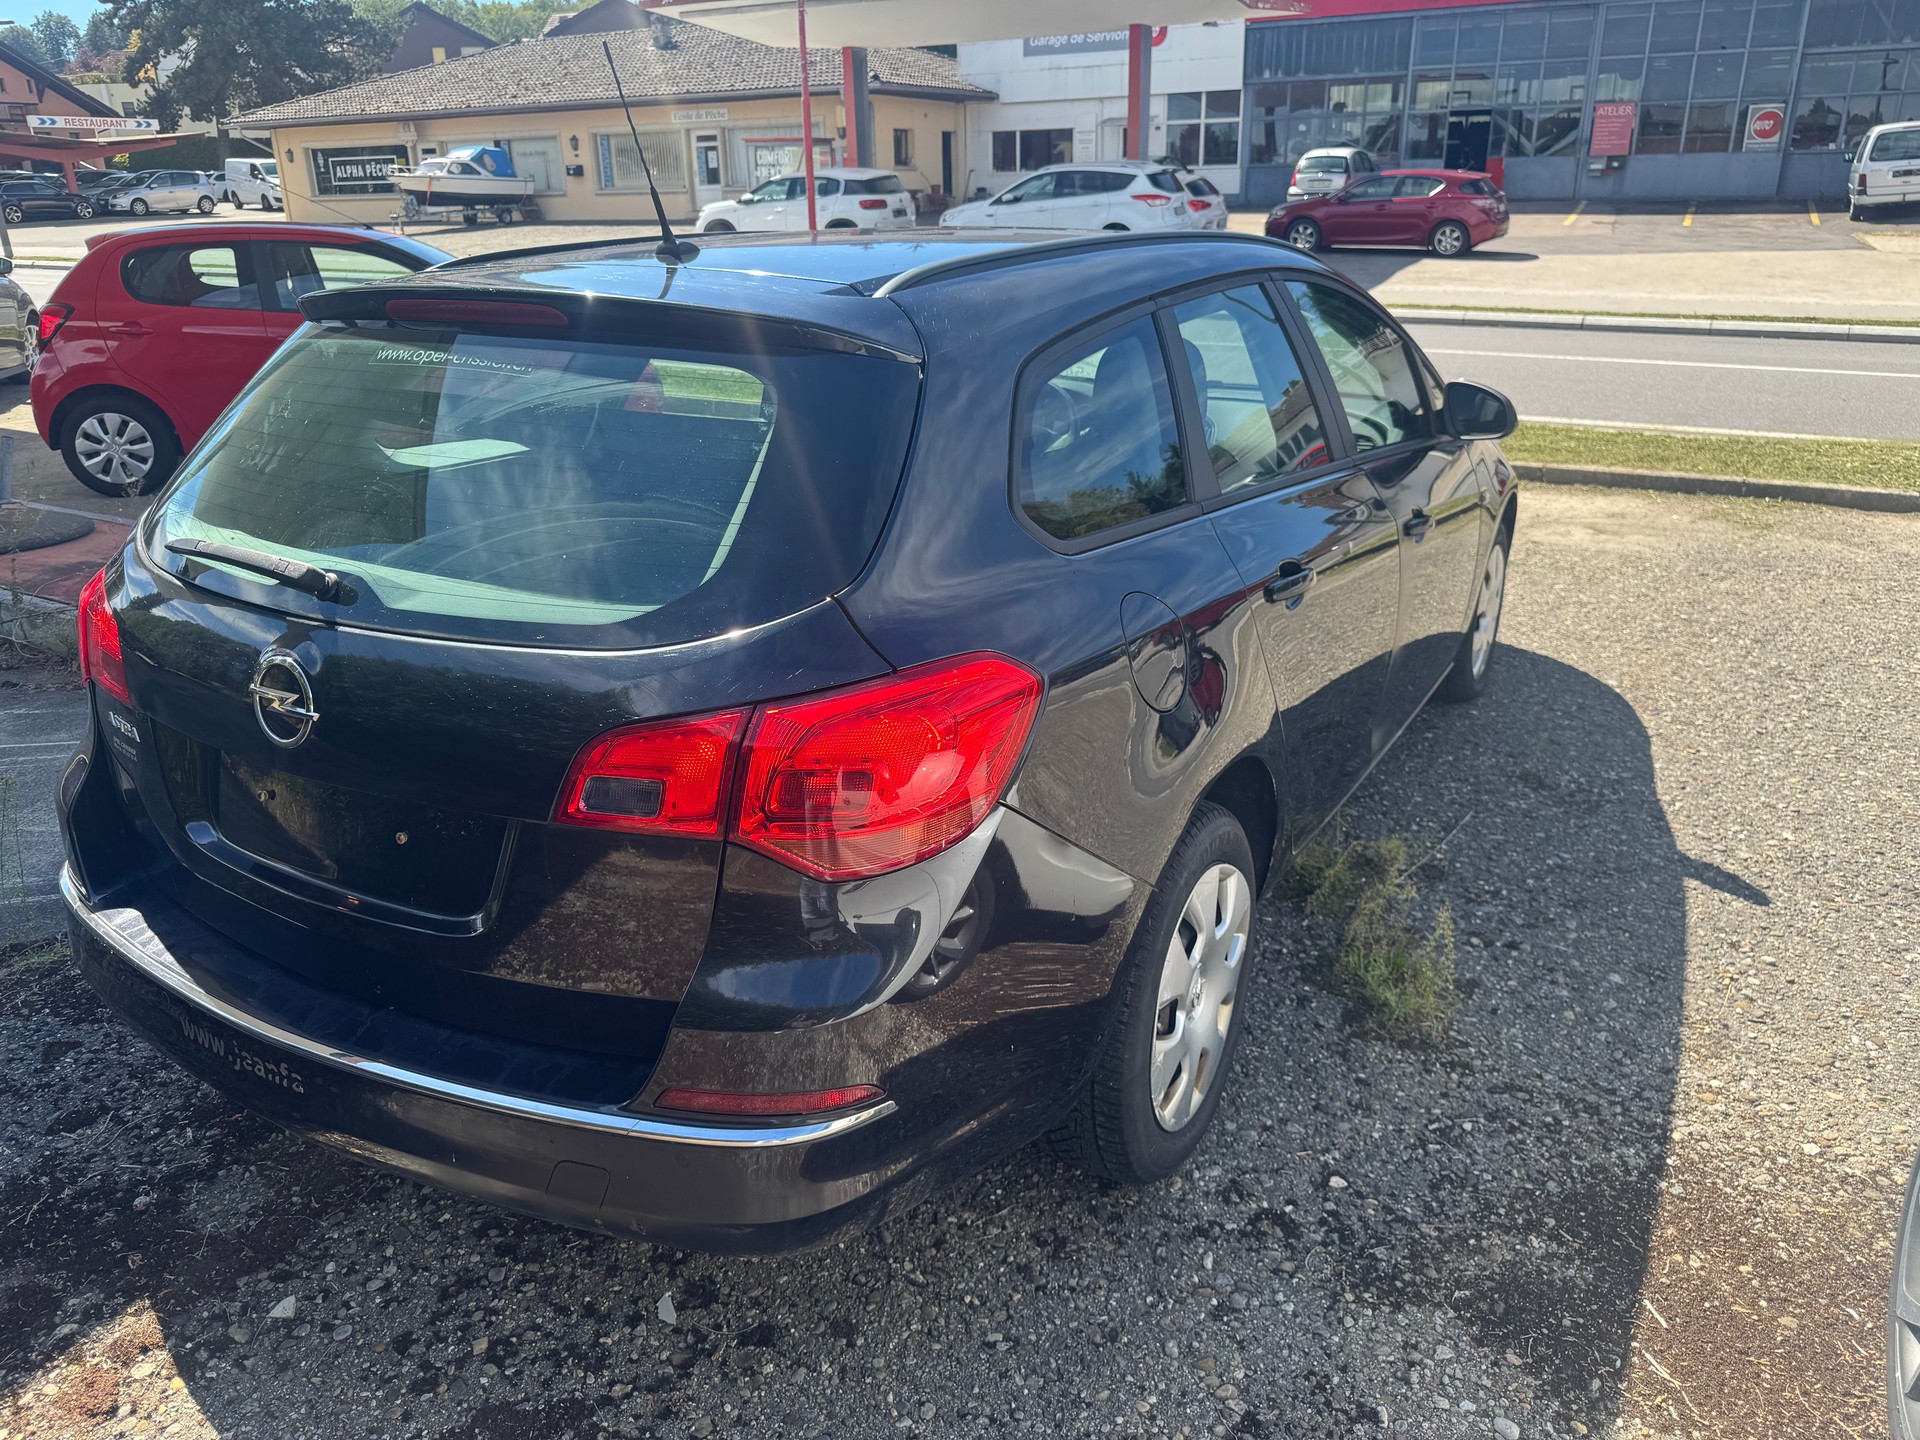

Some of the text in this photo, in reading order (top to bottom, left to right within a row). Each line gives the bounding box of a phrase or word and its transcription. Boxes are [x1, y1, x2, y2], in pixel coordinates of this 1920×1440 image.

[1029, 29, 1129, 47] Garage de Servion
[1597, 105, 1633, 117] ATELIER
[63, 117, 128, 128] RESTAURANT
[335, 163, 364, 178] ALPHA
[108, 710, 141, 743] ASTRA
